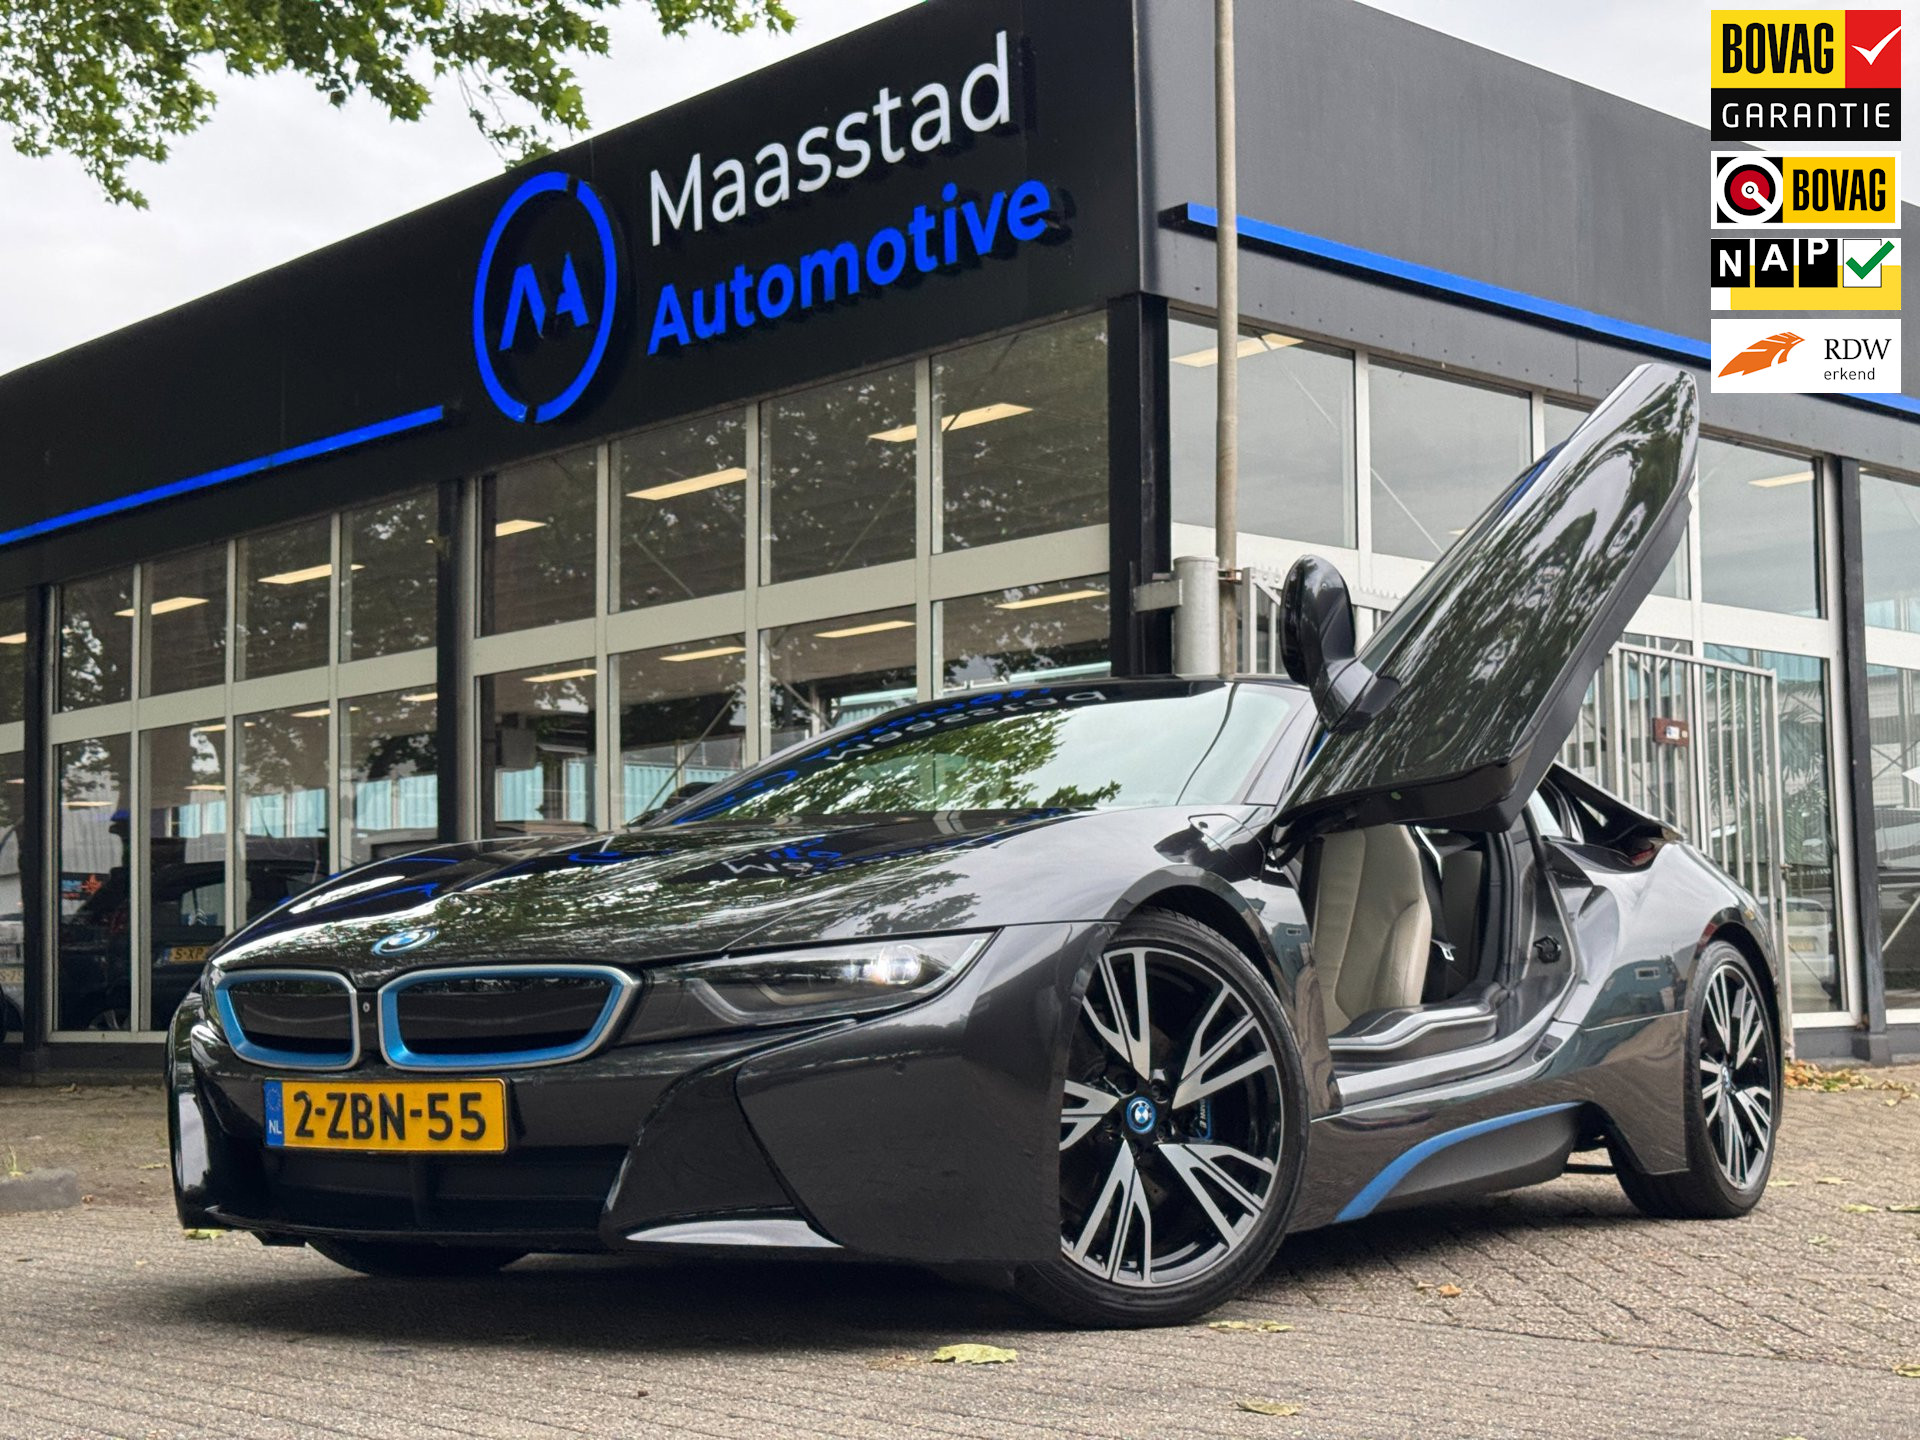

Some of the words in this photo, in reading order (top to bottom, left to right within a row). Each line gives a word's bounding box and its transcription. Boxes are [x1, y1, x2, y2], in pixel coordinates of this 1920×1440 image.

[650, 31, 1010, 247] Maasstad
[647, 180, 1051, 355] Automotive
[268, 1119, 282, 1134] NL
[293, 1090, 486, 1141] 2-ZBN-55
